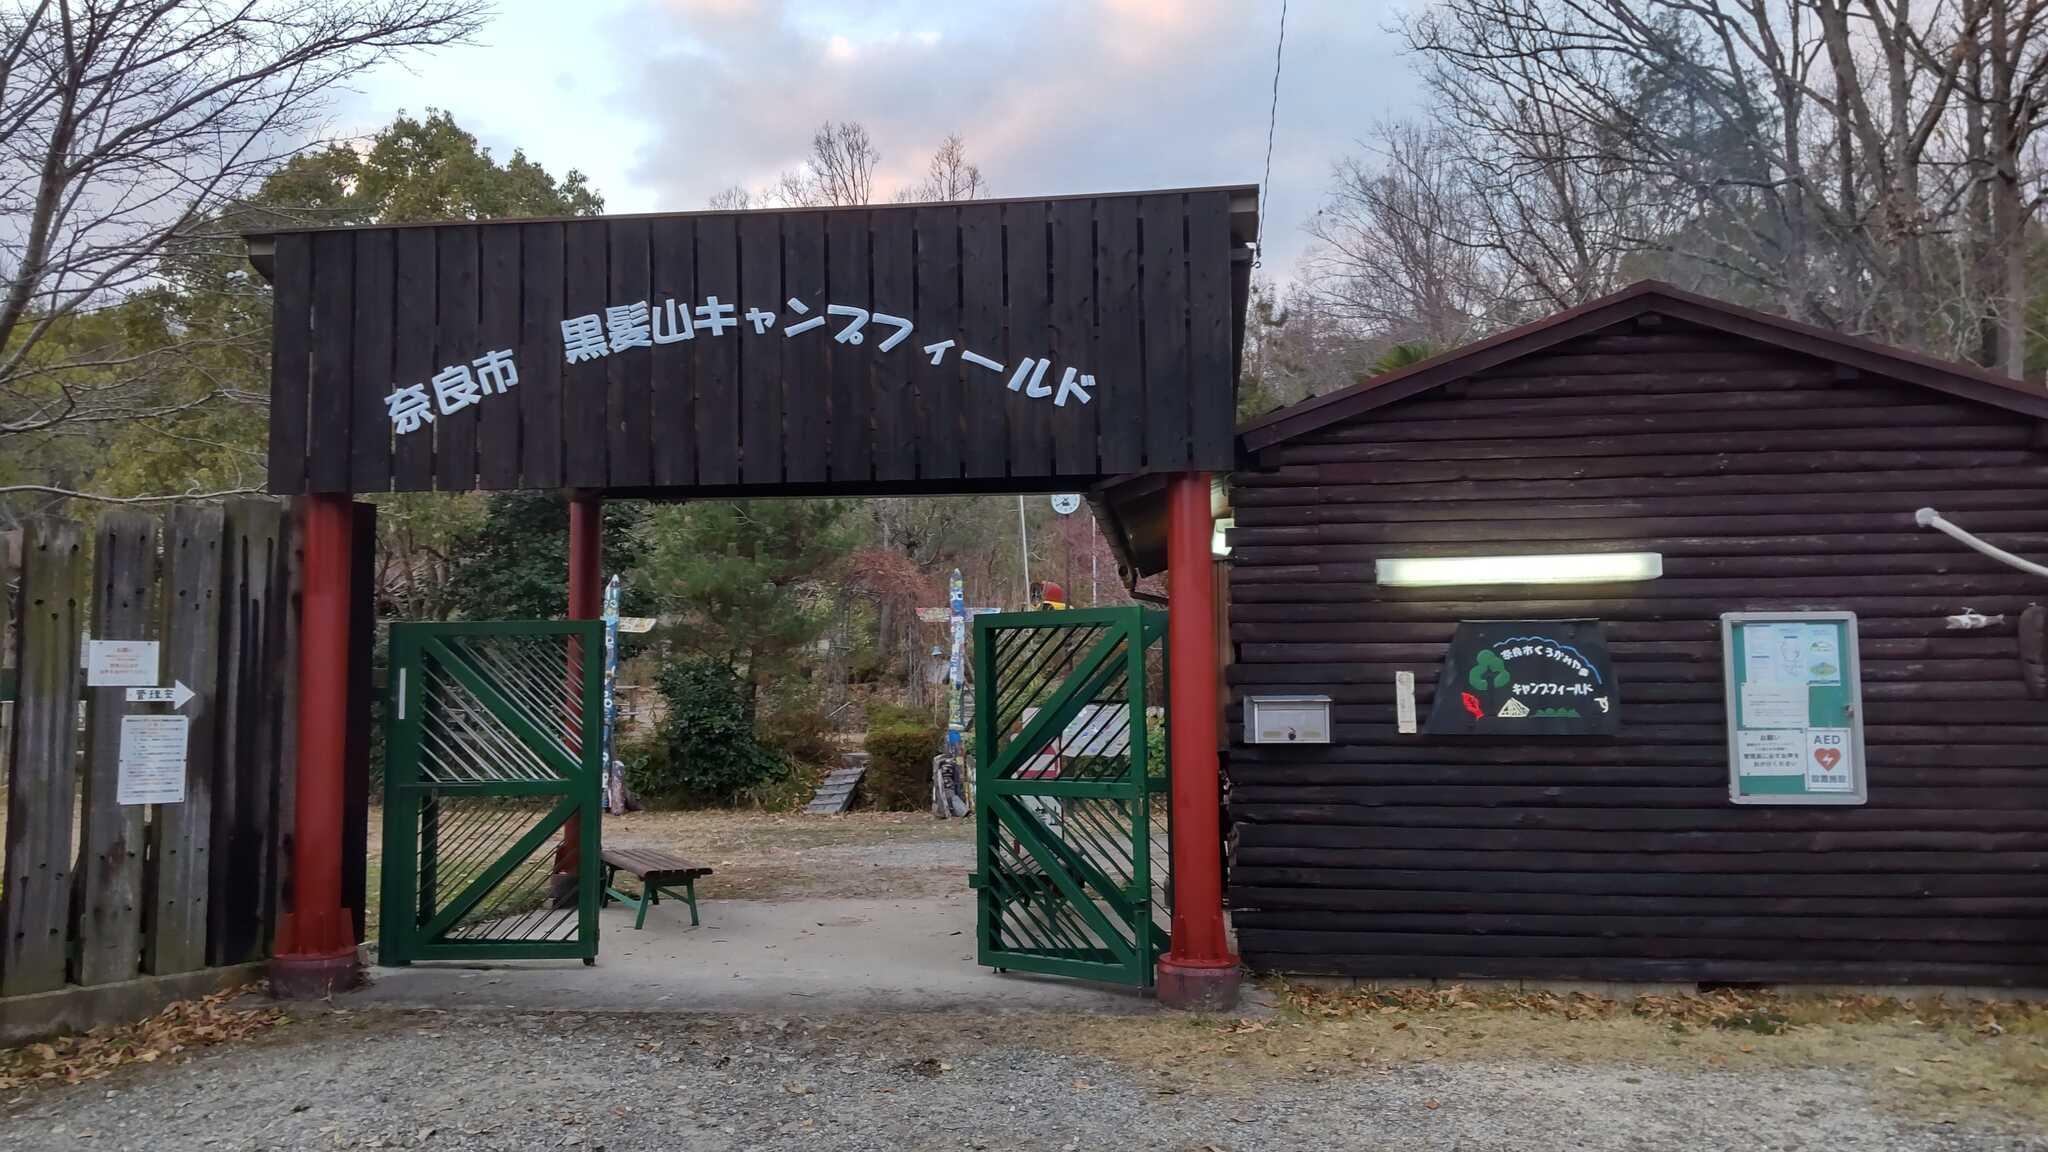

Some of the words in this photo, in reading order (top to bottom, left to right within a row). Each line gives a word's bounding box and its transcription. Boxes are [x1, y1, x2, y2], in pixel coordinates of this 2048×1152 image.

[384, 349, 519, 435] 奈良市
[560, 295, 1096, 407] 黒髪山キャンプフィールド
[1813, 735, 1841, 745] AED
